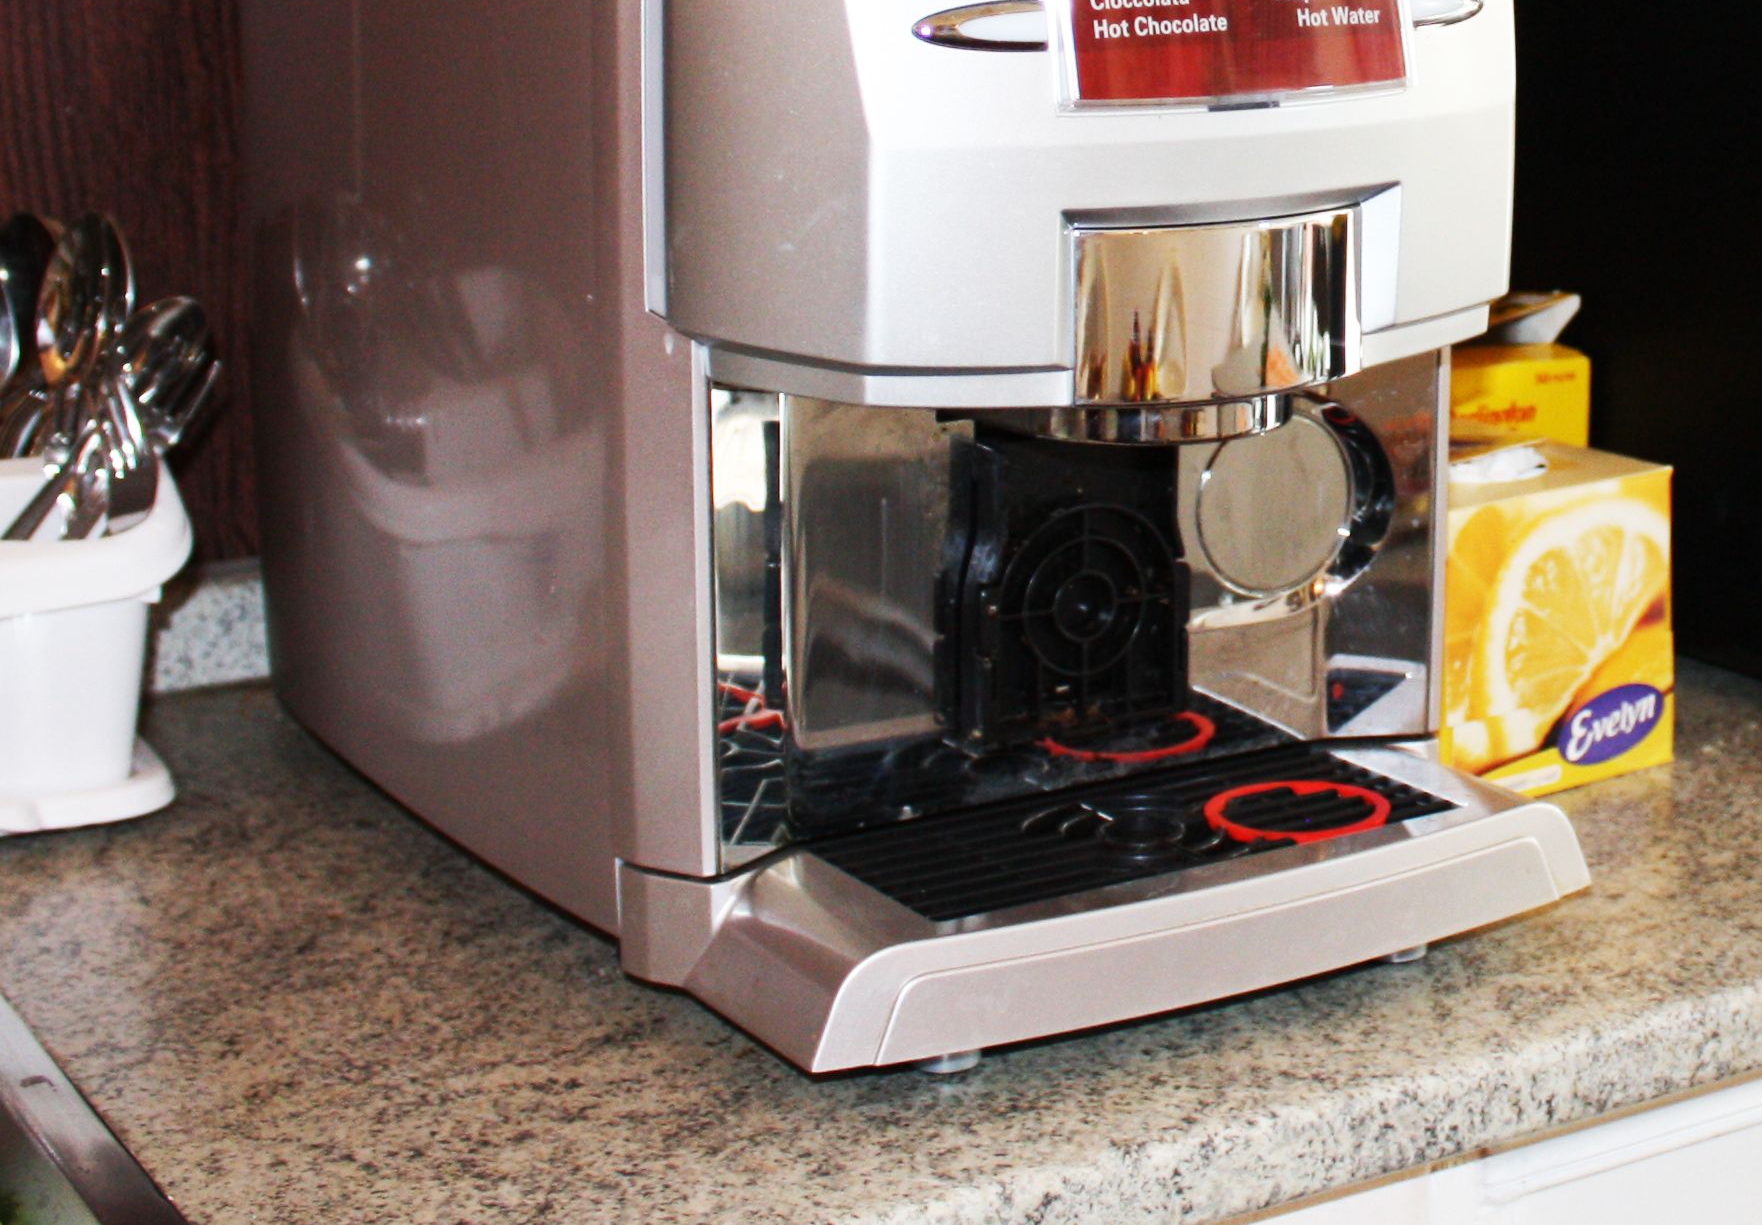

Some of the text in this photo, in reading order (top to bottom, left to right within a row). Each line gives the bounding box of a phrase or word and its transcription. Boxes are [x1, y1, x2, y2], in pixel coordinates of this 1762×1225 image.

[1094, 14, 1227, 38] Hot Chocolate
[1297, 6, 1380, 26] Hot Water
[1565, 693, 1657, 762] Evelyn
